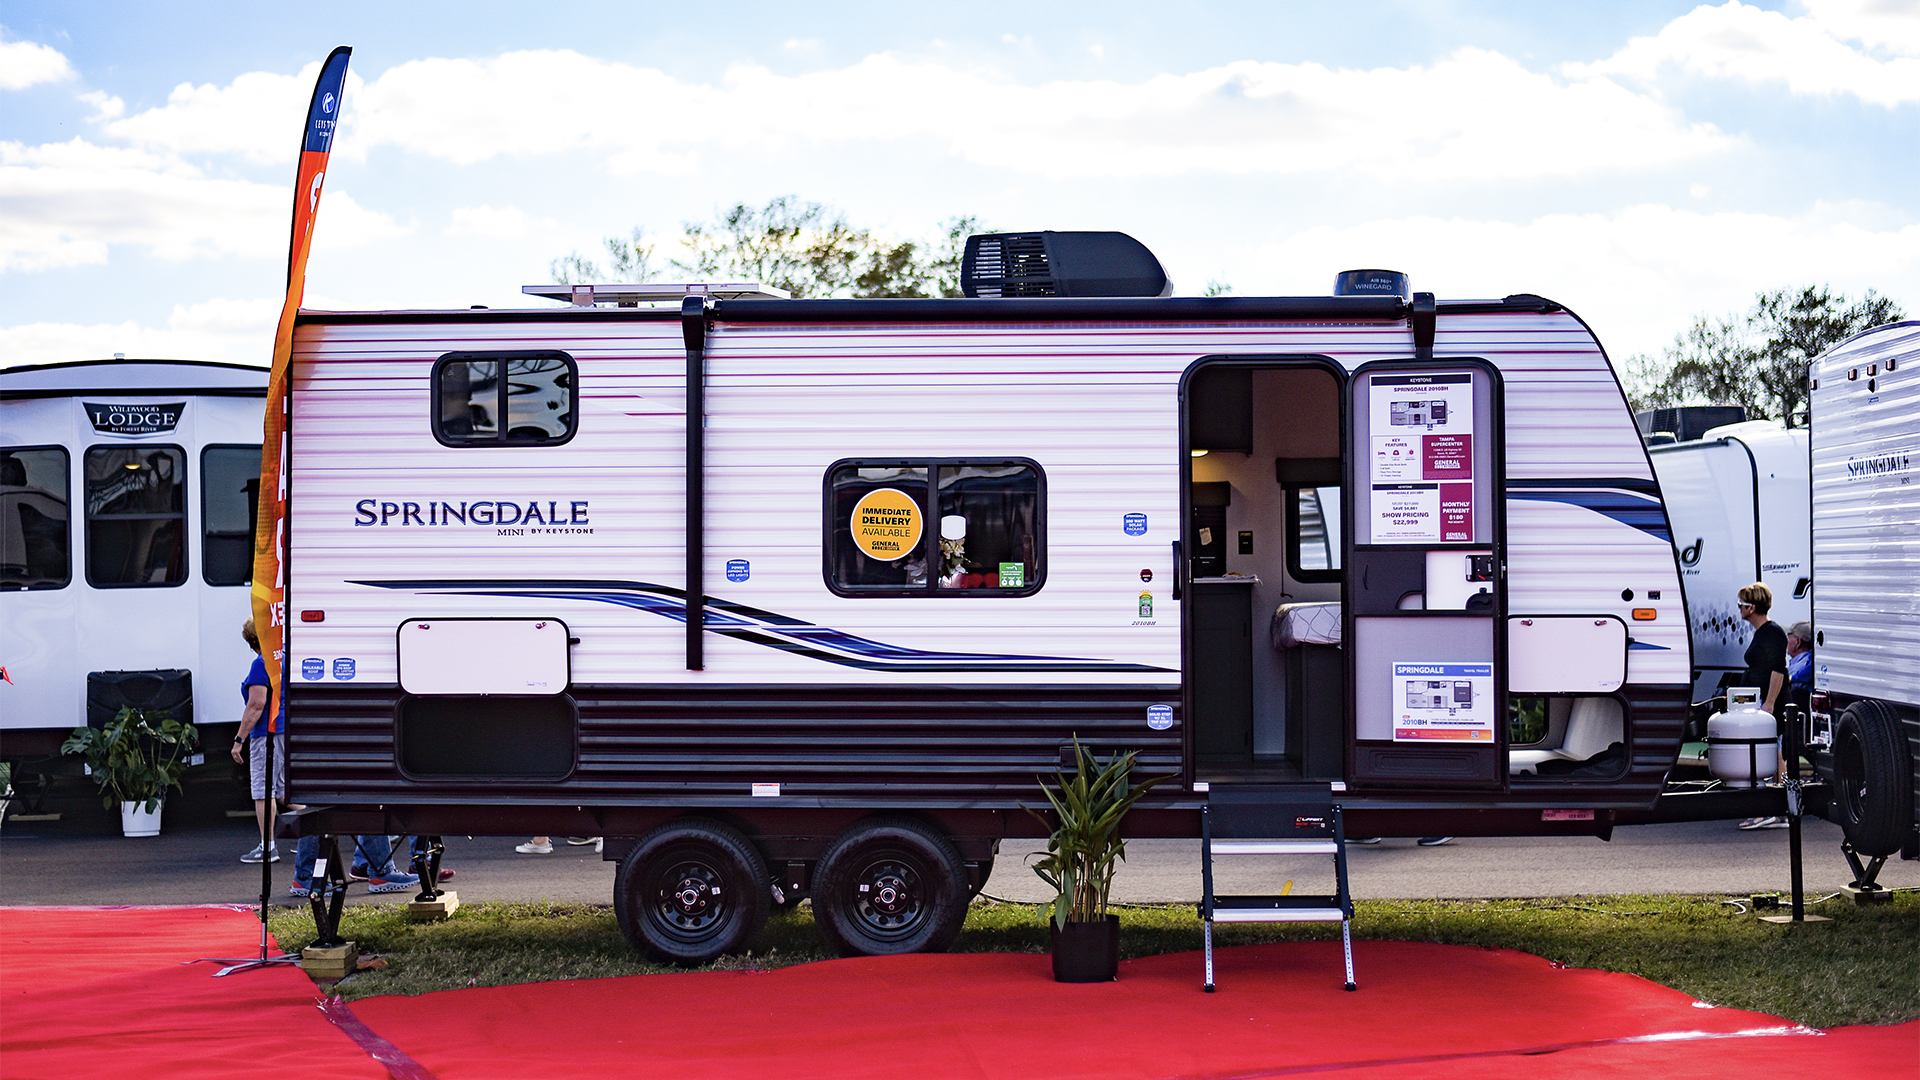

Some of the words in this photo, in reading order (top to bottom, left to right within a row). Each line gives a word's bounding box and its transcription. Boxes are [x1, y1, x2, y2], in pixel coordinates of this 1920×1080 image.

[1354, 283, 1392, 291] WINEGARD
[94, 412, 176, 426] LODGE
[354, 498, 590, 527] SPRINGDALE
[862, 508, 912, 516] IMMEDIATE
[862, 516, 911, 526] DELIVERY
[497, 528, 524, 536] MINI
[862, 528, 911, 538] AVAILABLE
[1397, 666, 1444, 674] SPRINGDALE
